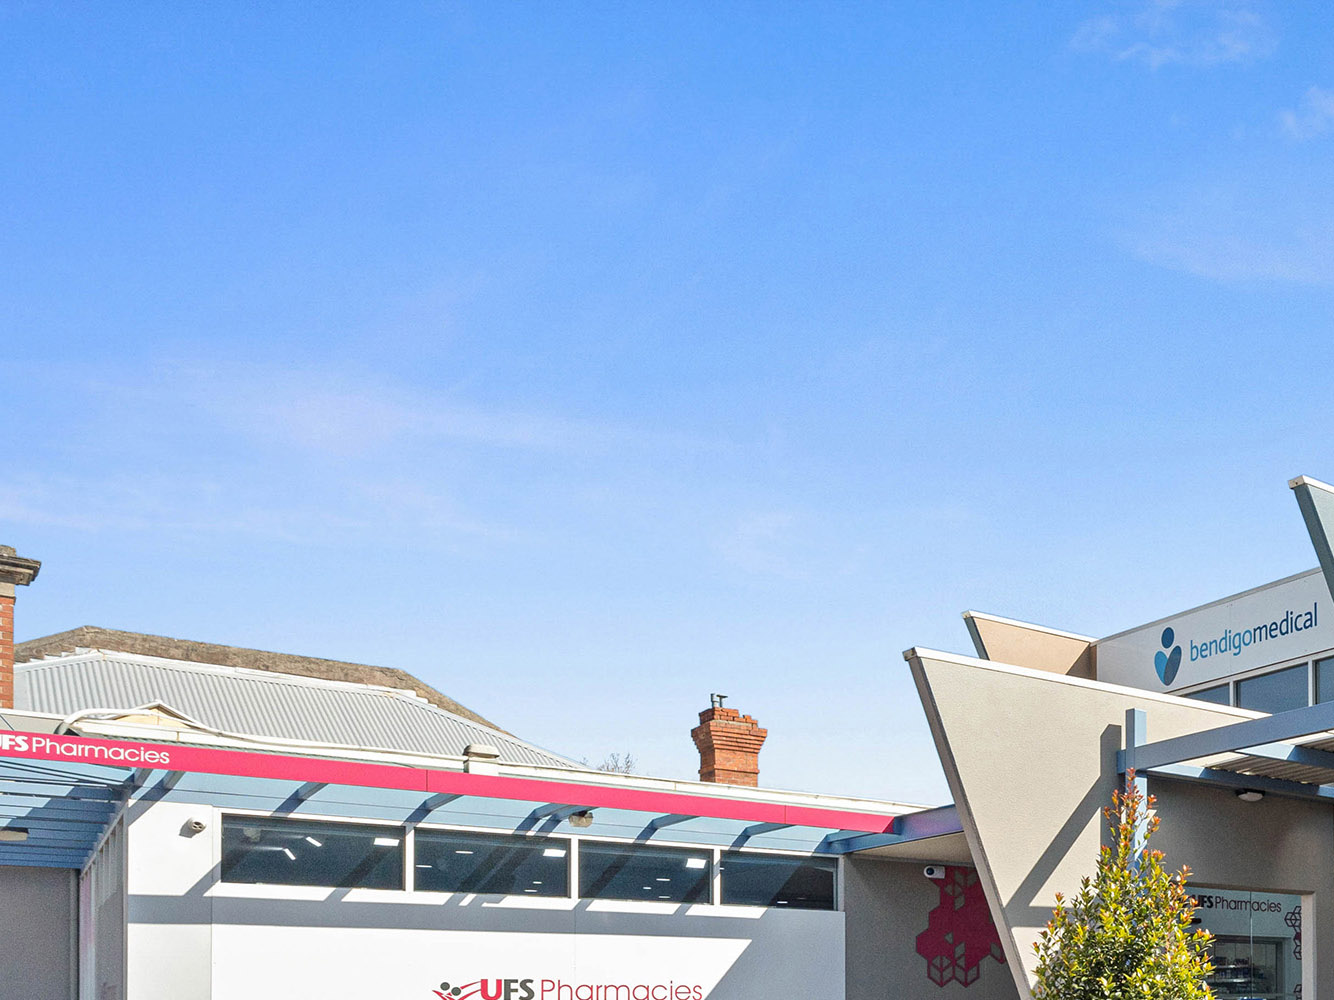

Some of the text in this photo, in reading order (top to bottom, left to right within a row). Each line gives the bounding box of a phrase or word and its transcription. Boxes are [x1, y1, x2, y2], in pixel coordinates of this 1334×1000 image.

[1190, 602, 1318, 662] bendigomedical
[0, 734, 170, 764] FS Pharmacies
[1215, 896, 1282, 912] Pharmacies
[480, 979, 703, 1000] UFS Pharmacies
